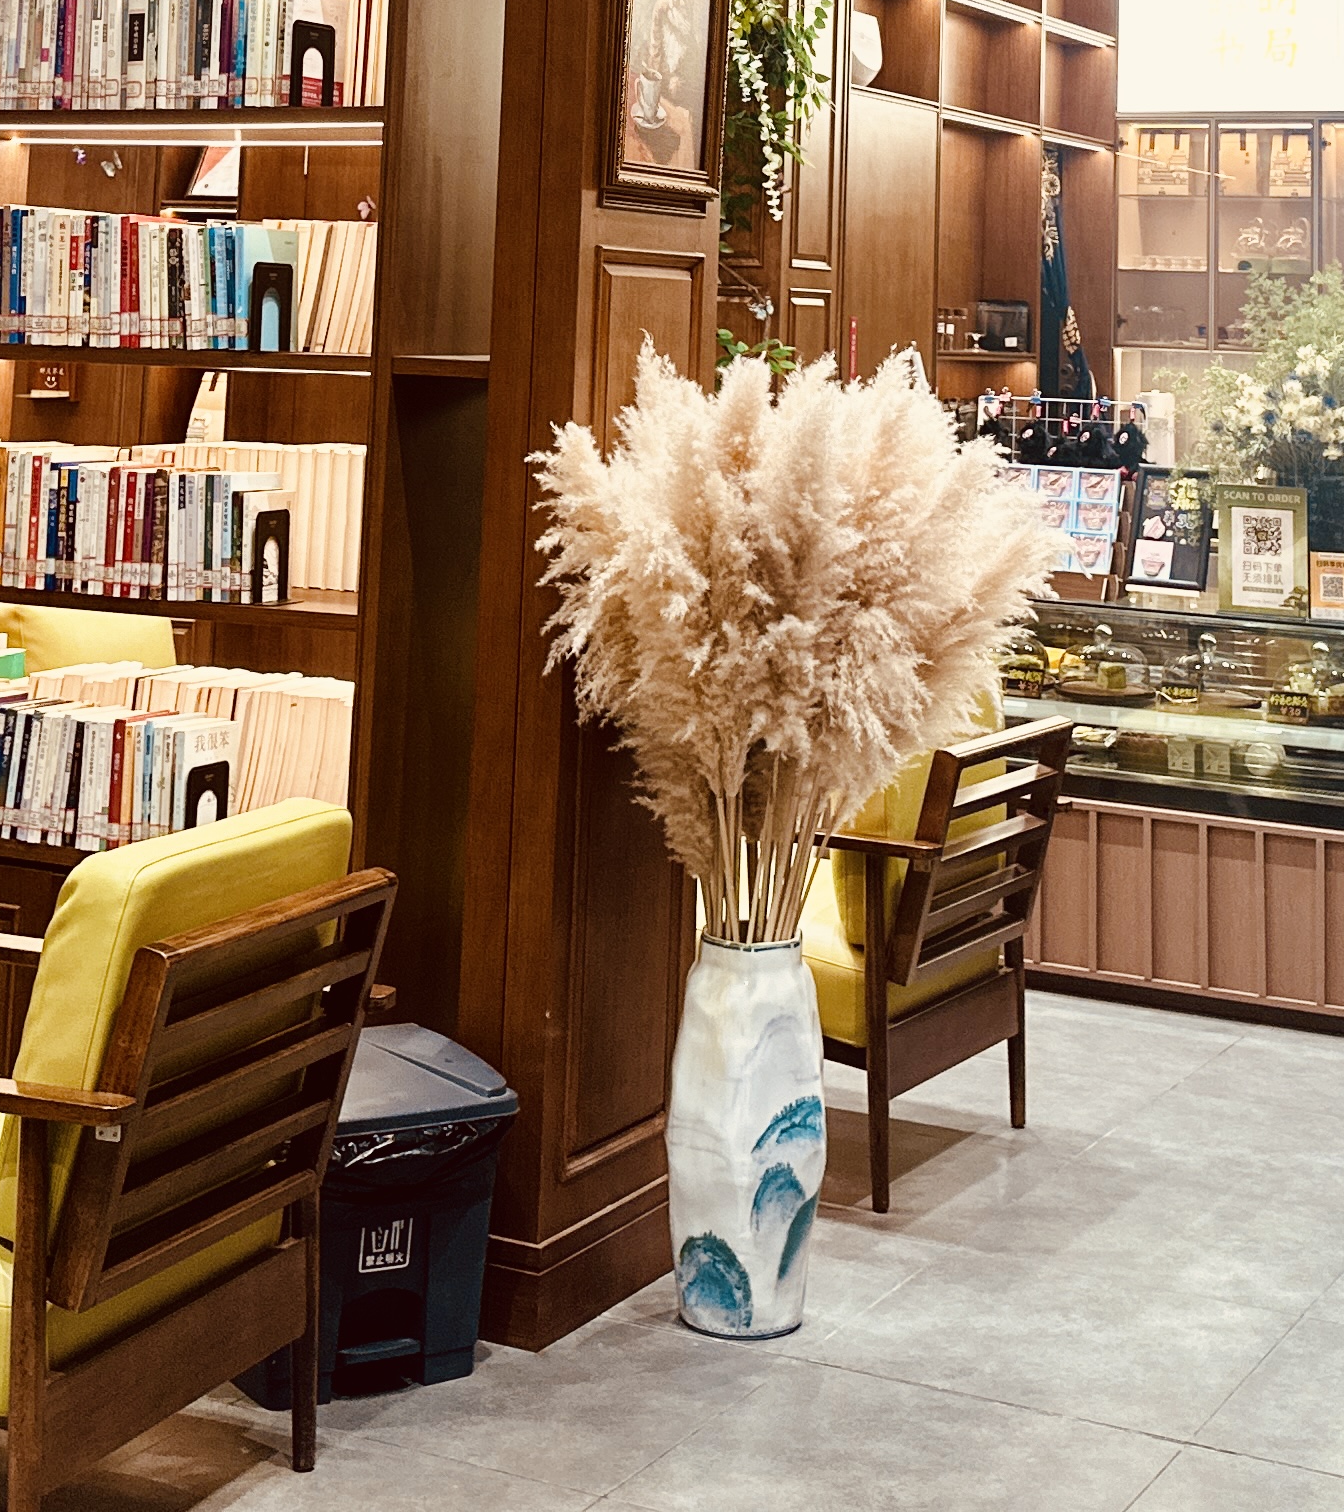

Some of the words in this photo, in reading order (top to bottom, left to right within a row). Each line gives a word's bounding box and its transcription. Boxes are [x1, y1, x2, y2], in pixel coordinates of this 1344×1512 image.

[1223, 490, 1250, 501] SCAN
[1253, 492, 1265, 502] TO
[1267, 494, 1301, 504] ORDER
[1242, 560, 1283, 573] 扫码下单
